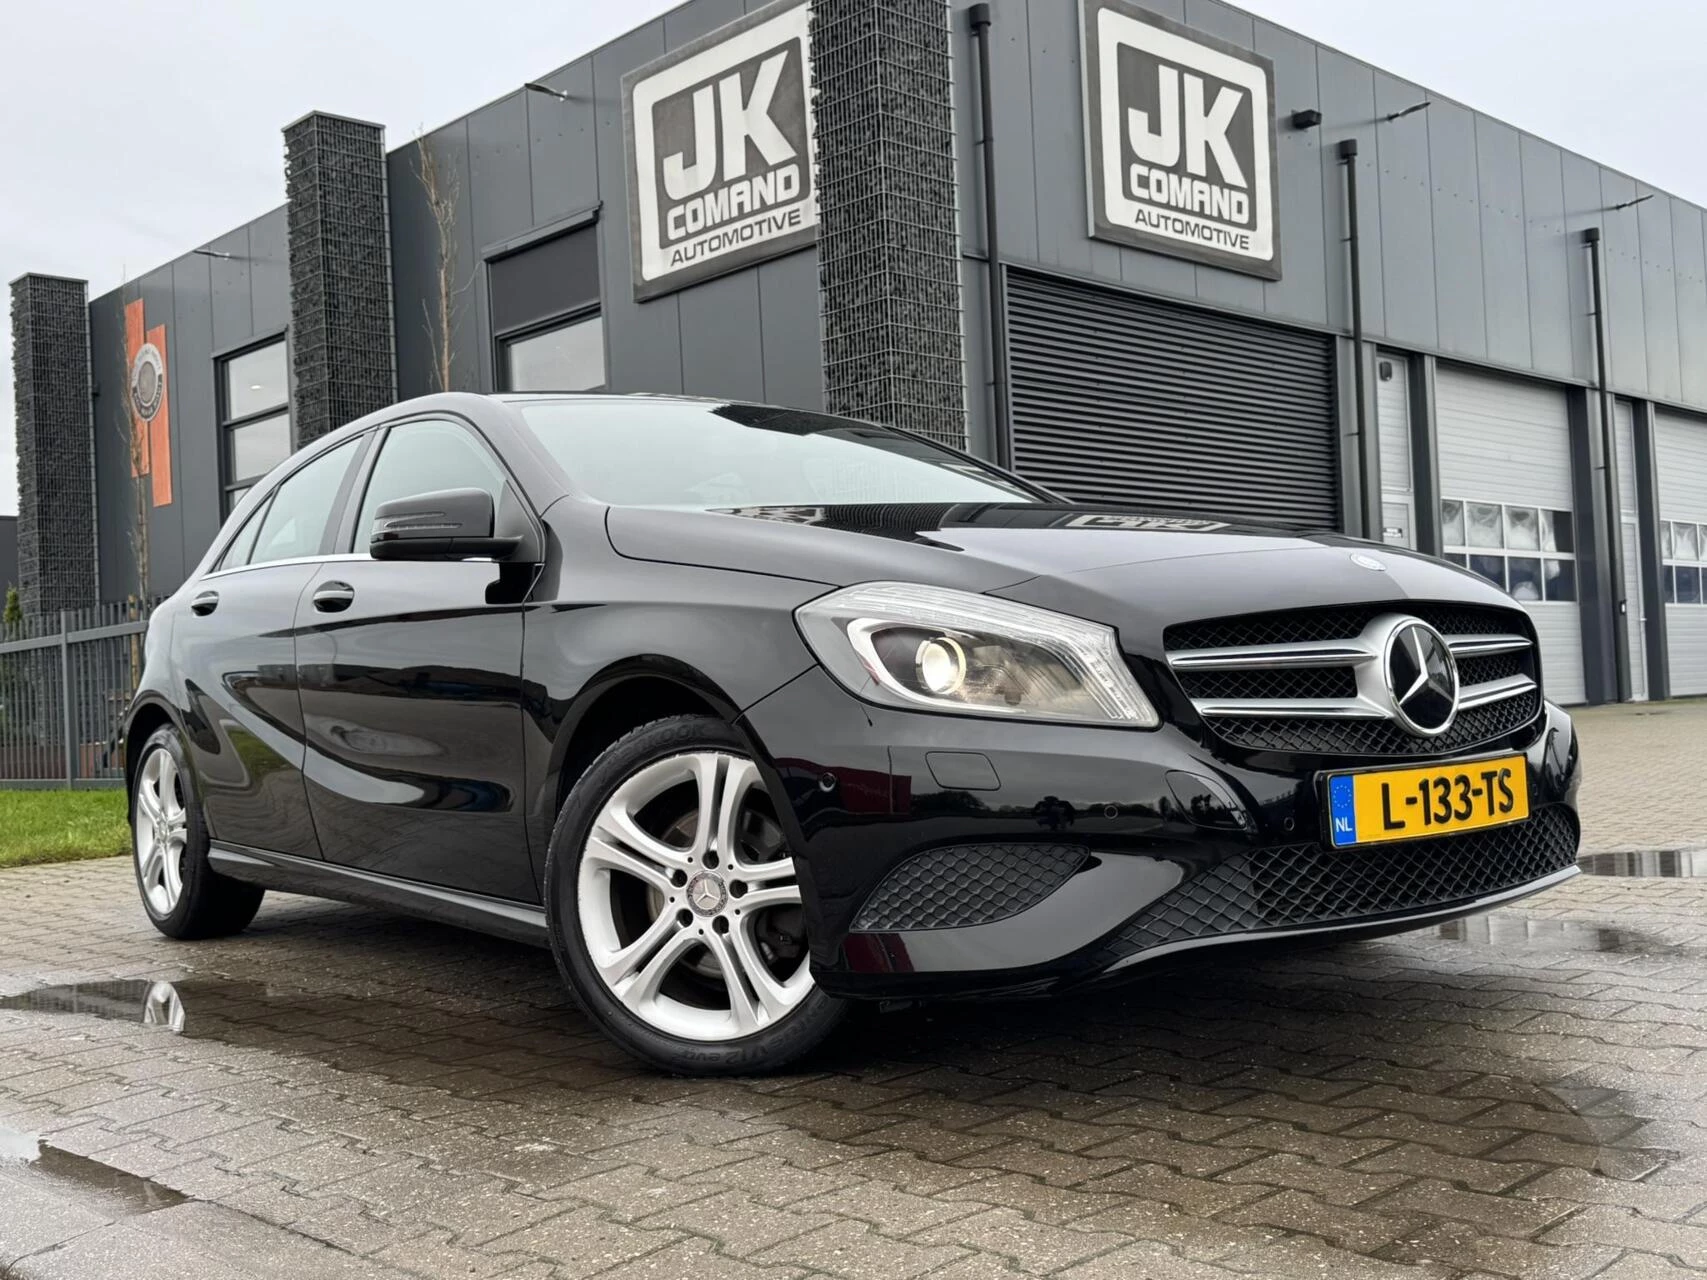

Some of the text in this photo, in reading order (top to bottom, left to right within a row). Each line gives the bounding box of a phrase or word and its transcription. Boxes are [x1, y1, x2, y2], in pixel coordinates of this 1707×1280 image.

[663, 50, 797, 200] JK
[1128, 64, 1248, 188] JK
[667, 163, 800, 241] COMAND
[1130, 163, 1249, 225] COMAND
[671, 208, 801, 266] AUTOMOTIVE
[1135, 209, 1249, 250] AUTOMOTIVE
[1335, 817, 1353, 832] NL
[1381, 768, 1514, 830] L-133-TS
